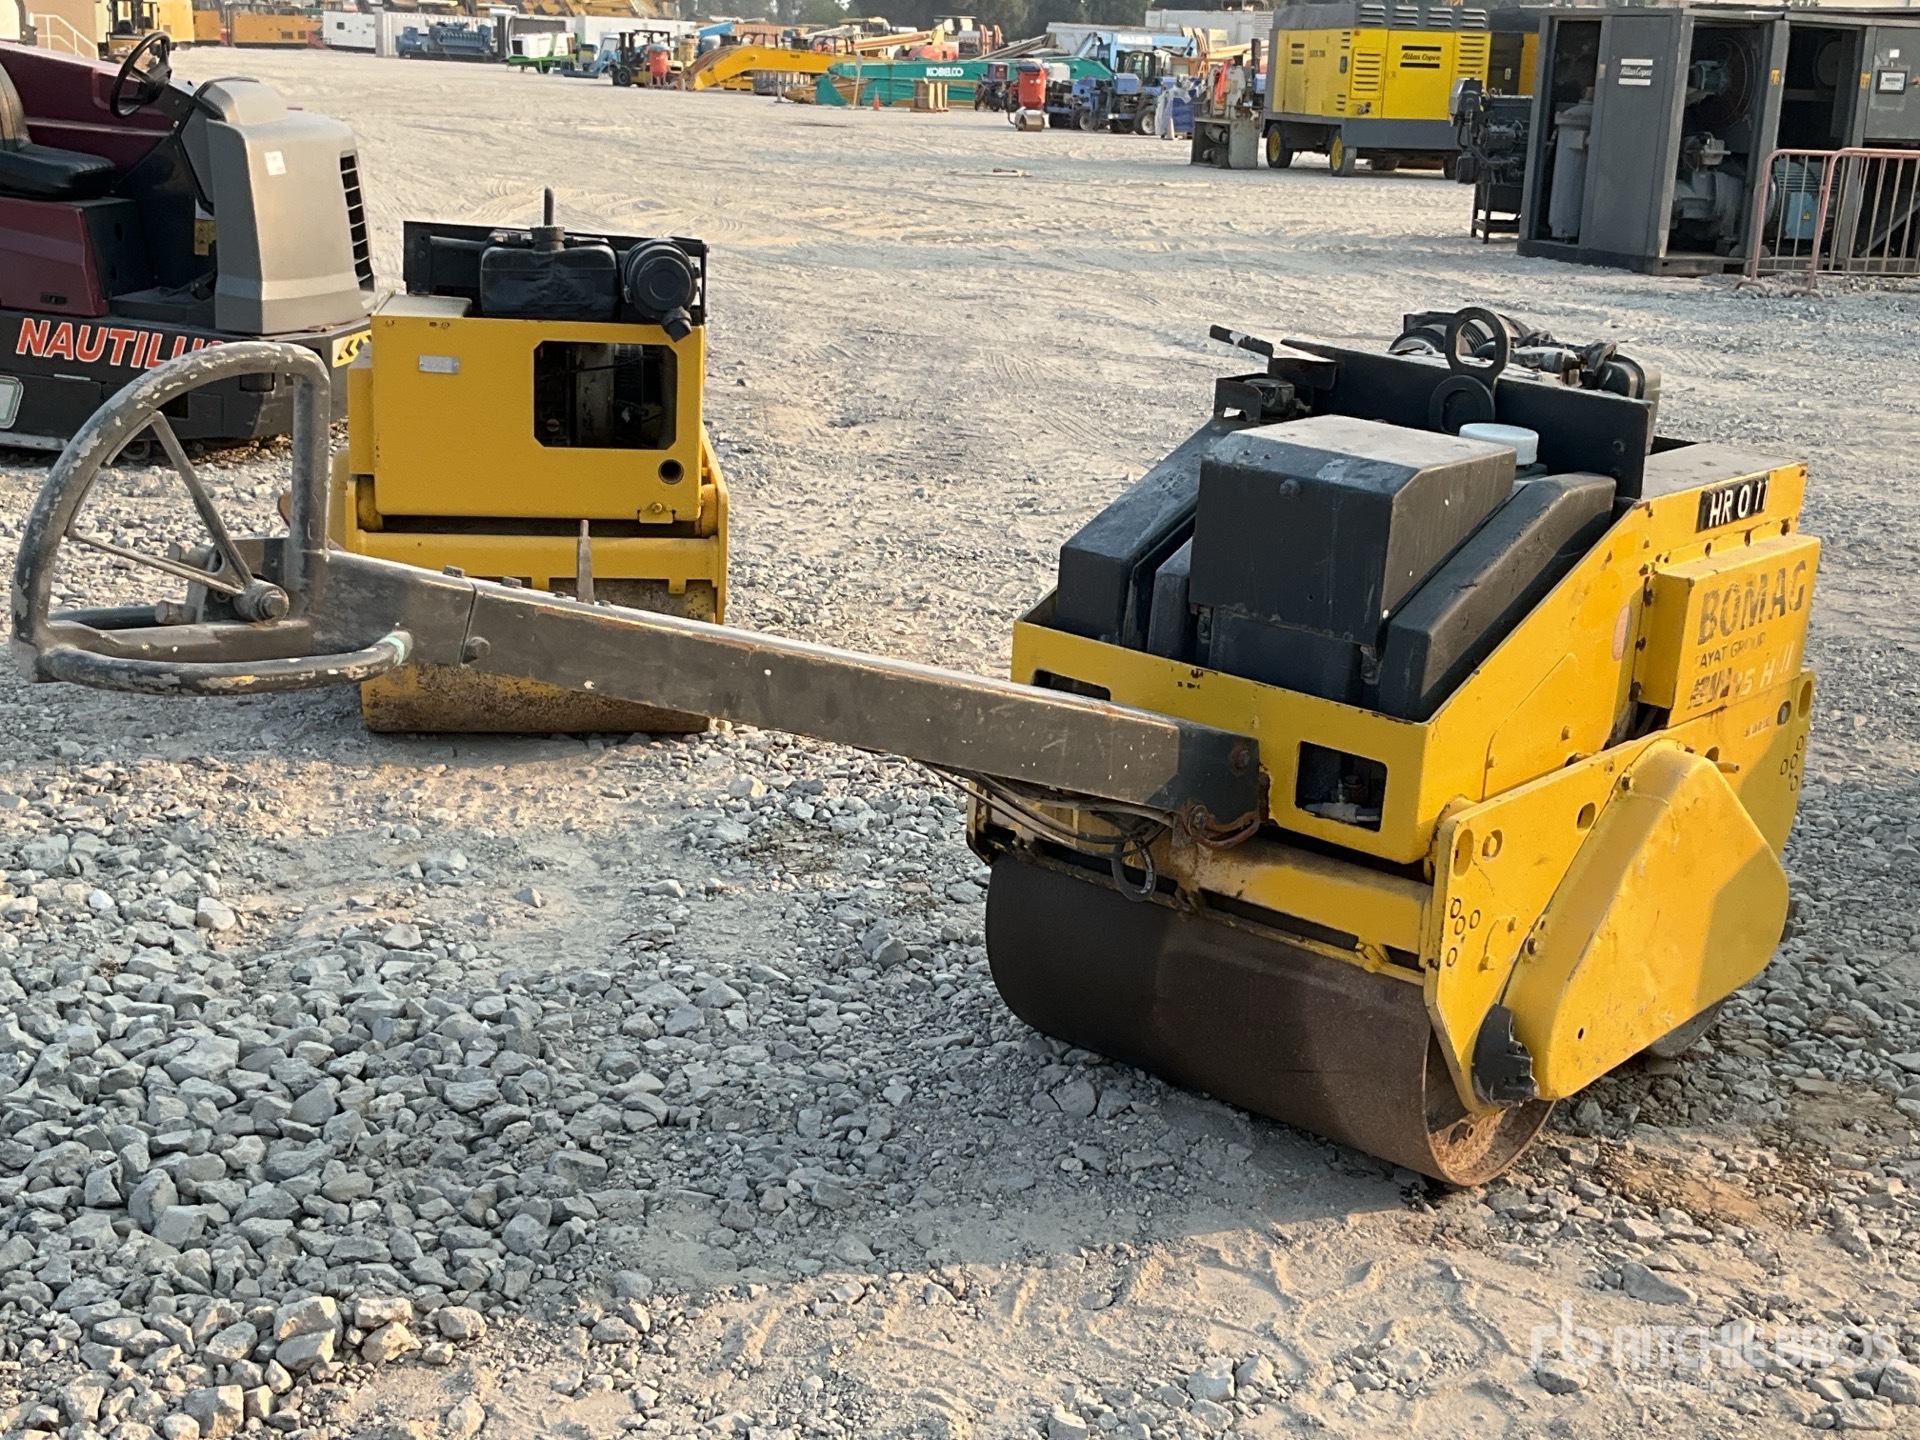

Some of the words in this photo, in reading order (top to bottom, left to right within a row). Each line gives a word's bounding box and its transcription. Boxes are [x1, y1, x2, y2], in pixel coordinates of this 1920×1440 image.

[926, 67, 964, 77] KOBELCO
[16, 318, 225, 370] NAUTIL
[1708, 489, 1733, 528] HR
[1697, 559, 1806, 646] BOMAG
